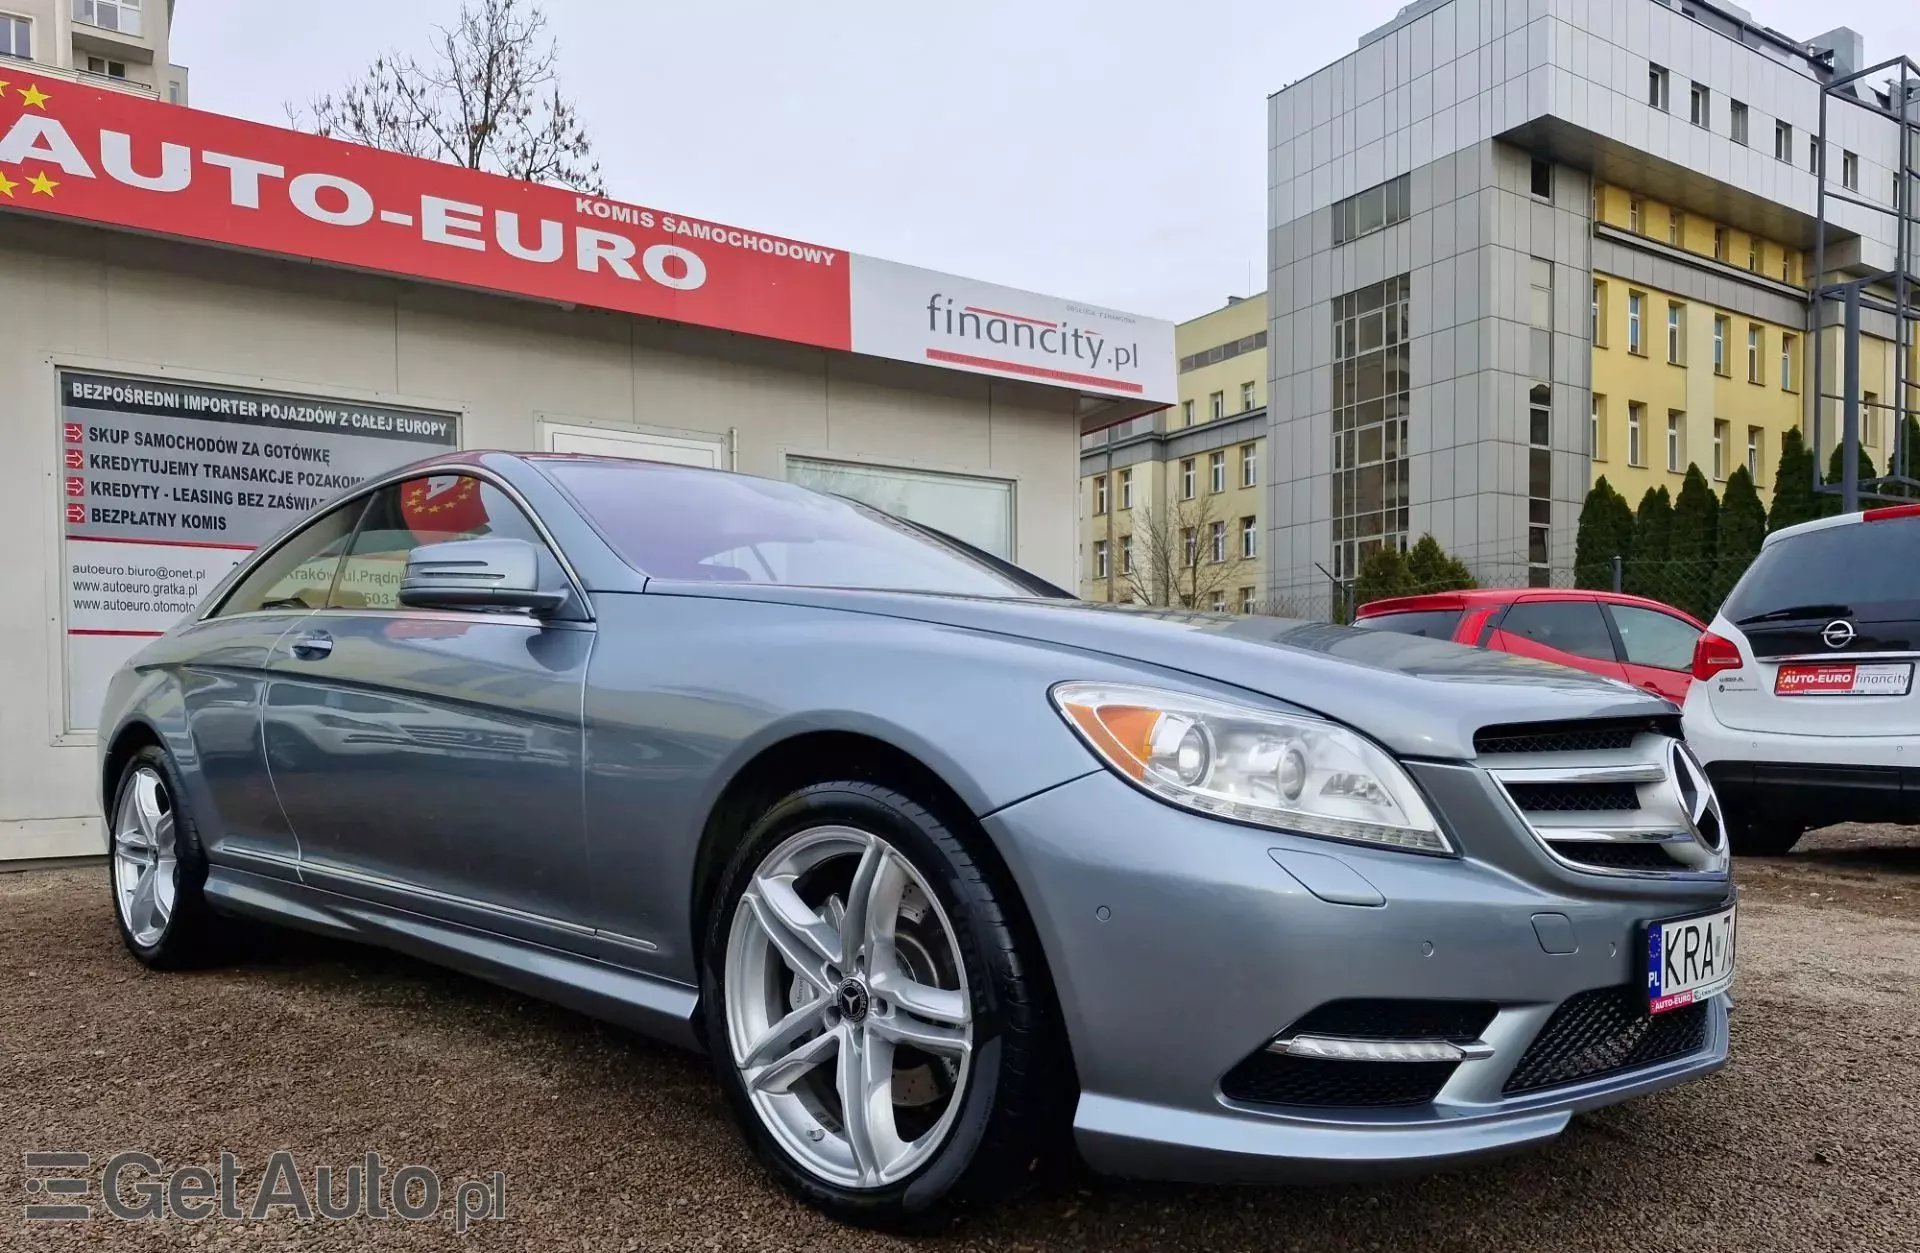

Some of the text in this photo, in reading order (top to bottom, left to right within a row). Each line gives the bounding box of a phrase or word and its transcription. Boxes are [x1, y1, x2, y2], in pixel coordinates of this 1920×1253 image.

[0, 113, 707, 290] AUTO-EURO
[575, 197, 836, 267] KOMIS SAMOCHODOWY
[926, 293, 1138, 372] financity.pl
[72, 382, 447, 437] BEZPOŚREDNI IMPORTER POJAZDÓW Z CAŁEJ EUROPY
[88, 426, 330, 467] SKUP SAMOCHODÓW ZA GOTÓWKĘ
[89, 453, 365, 489] KREDYTUJEMY TRANSAKCJE POZAKOM
[90, 480, 160, 500] KREDYTY
[173, 487, 233, 506] LEASING
[237, 492, 265, 508] BEZ
[91, 507, 227, 531] BEZPŁATNY KOMIS
[72, 563, 206, 580] autoeuro.biuro@onet.pl
[73, 580, 198, 598] www.autoeuro.gratka.pl
[1784, 673, 1852, 684] AUTO-EURO
[1665, 922, 1714, 989] KRA
[1648, 971, 1660, 989] PL
[1655, 992, 1692, 1011] AUTO-EURO
